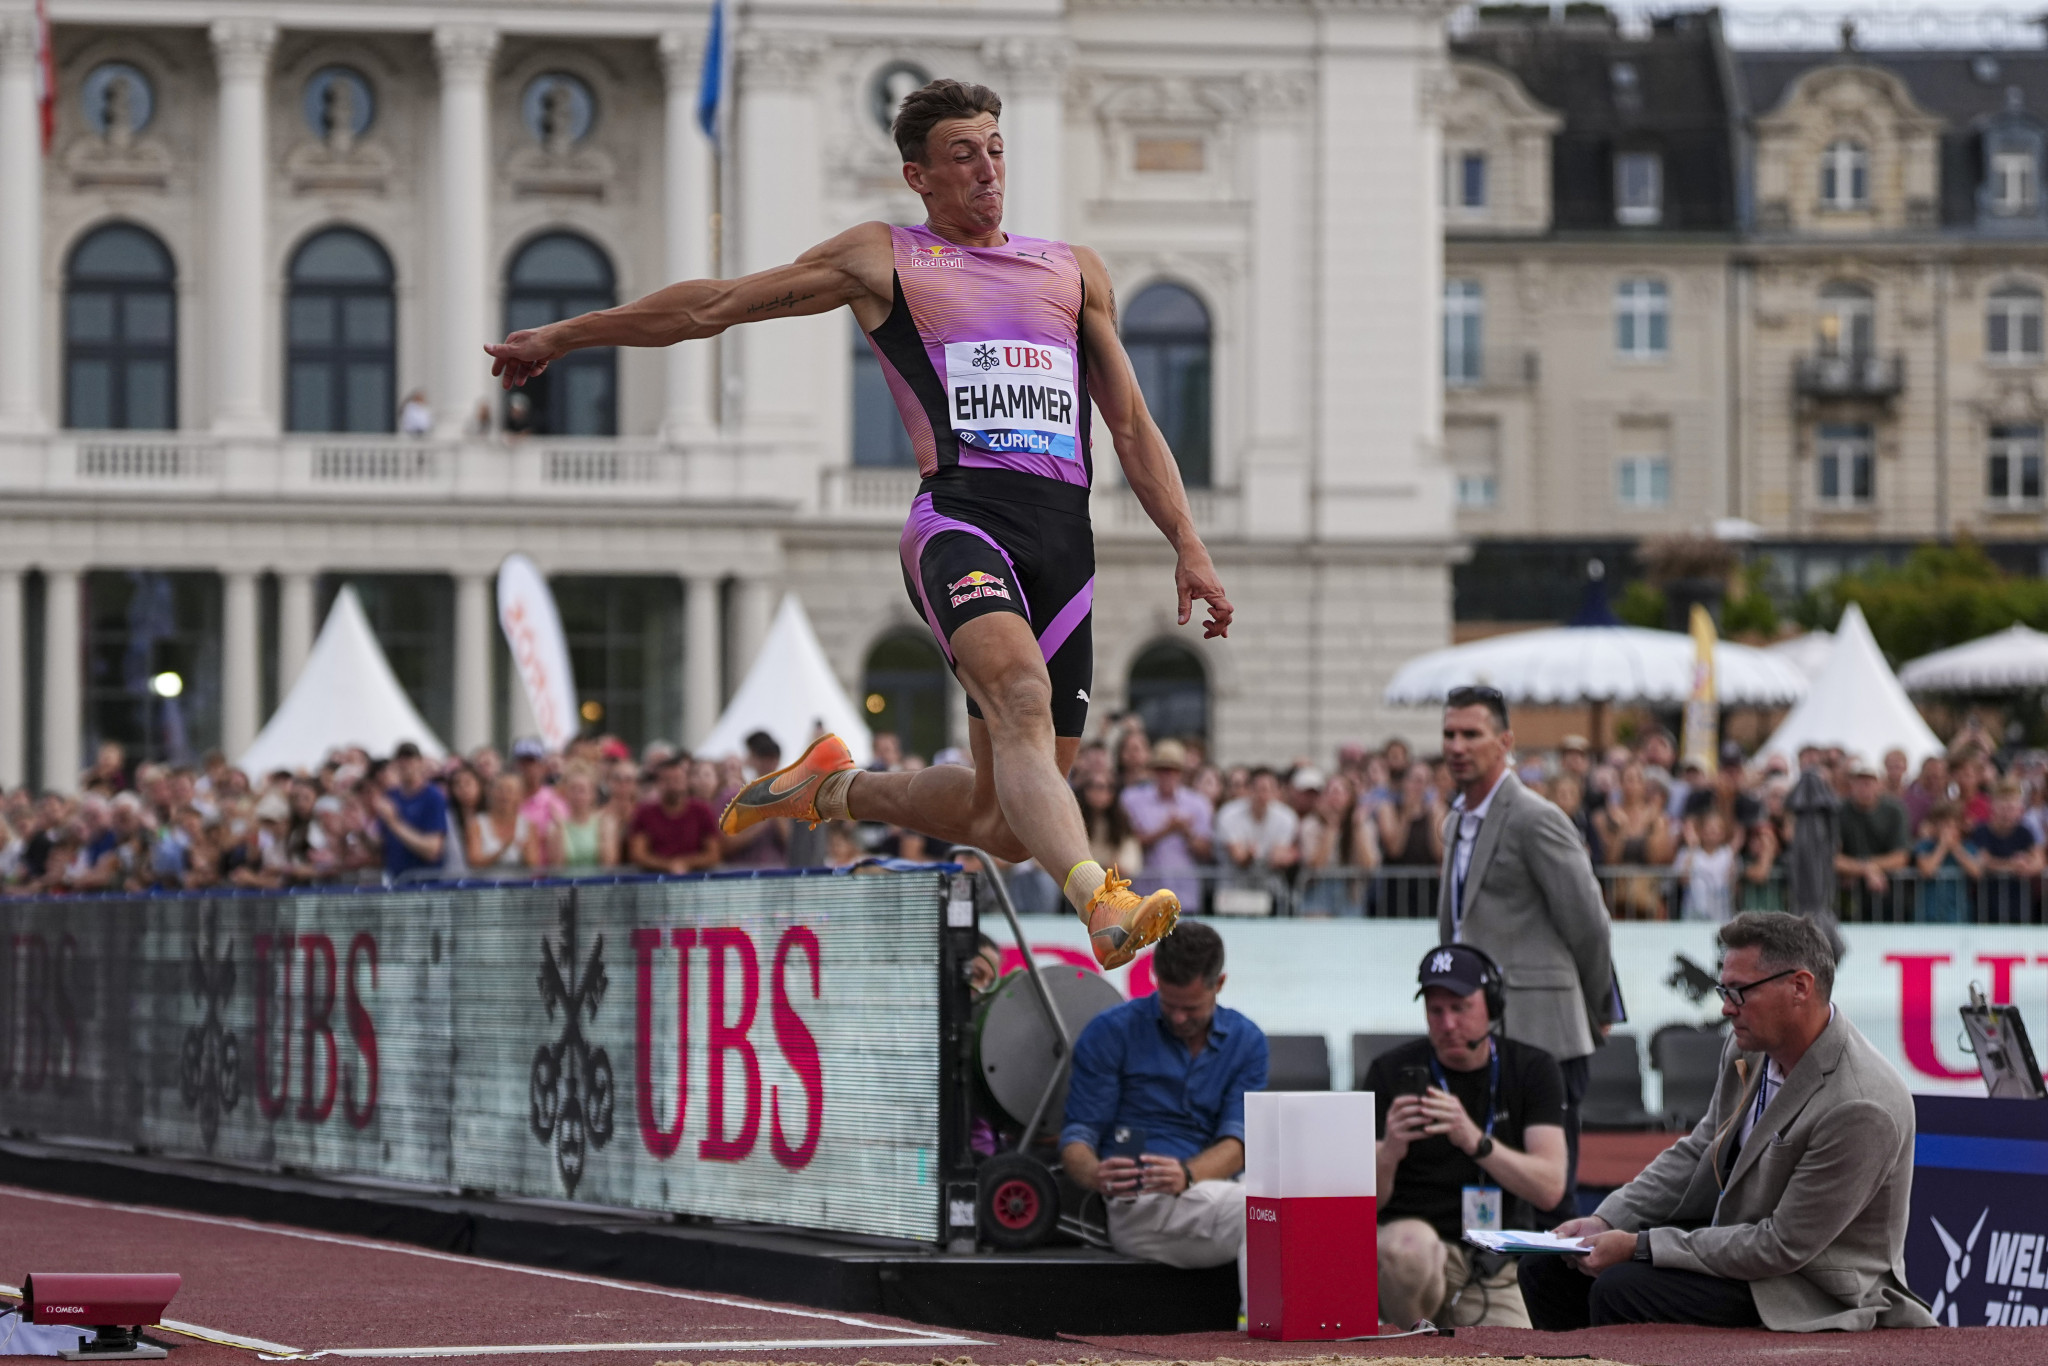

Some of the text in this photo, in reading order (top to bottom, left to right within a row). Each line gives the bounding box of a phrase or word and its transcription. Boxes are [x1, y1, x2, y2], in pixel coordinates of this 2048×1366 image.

[912, 258, 964, 268] Red Bull
[1003, 346, 1053, 371] UBS
[955, 384, 1073, 425] EHAMMER
[988, 433, 1049, 449] ZURICH
[951, 586, 1012, 608] Red Bull
[254, 932, 379, 1131] UBS
[1882, 952, 2048, 1082] U
[629, 925, 824, 1173] UBS
[1257, 1209, 1277, 1222] OMEGA
[1985, 1230, 2048, 1290] WEL
